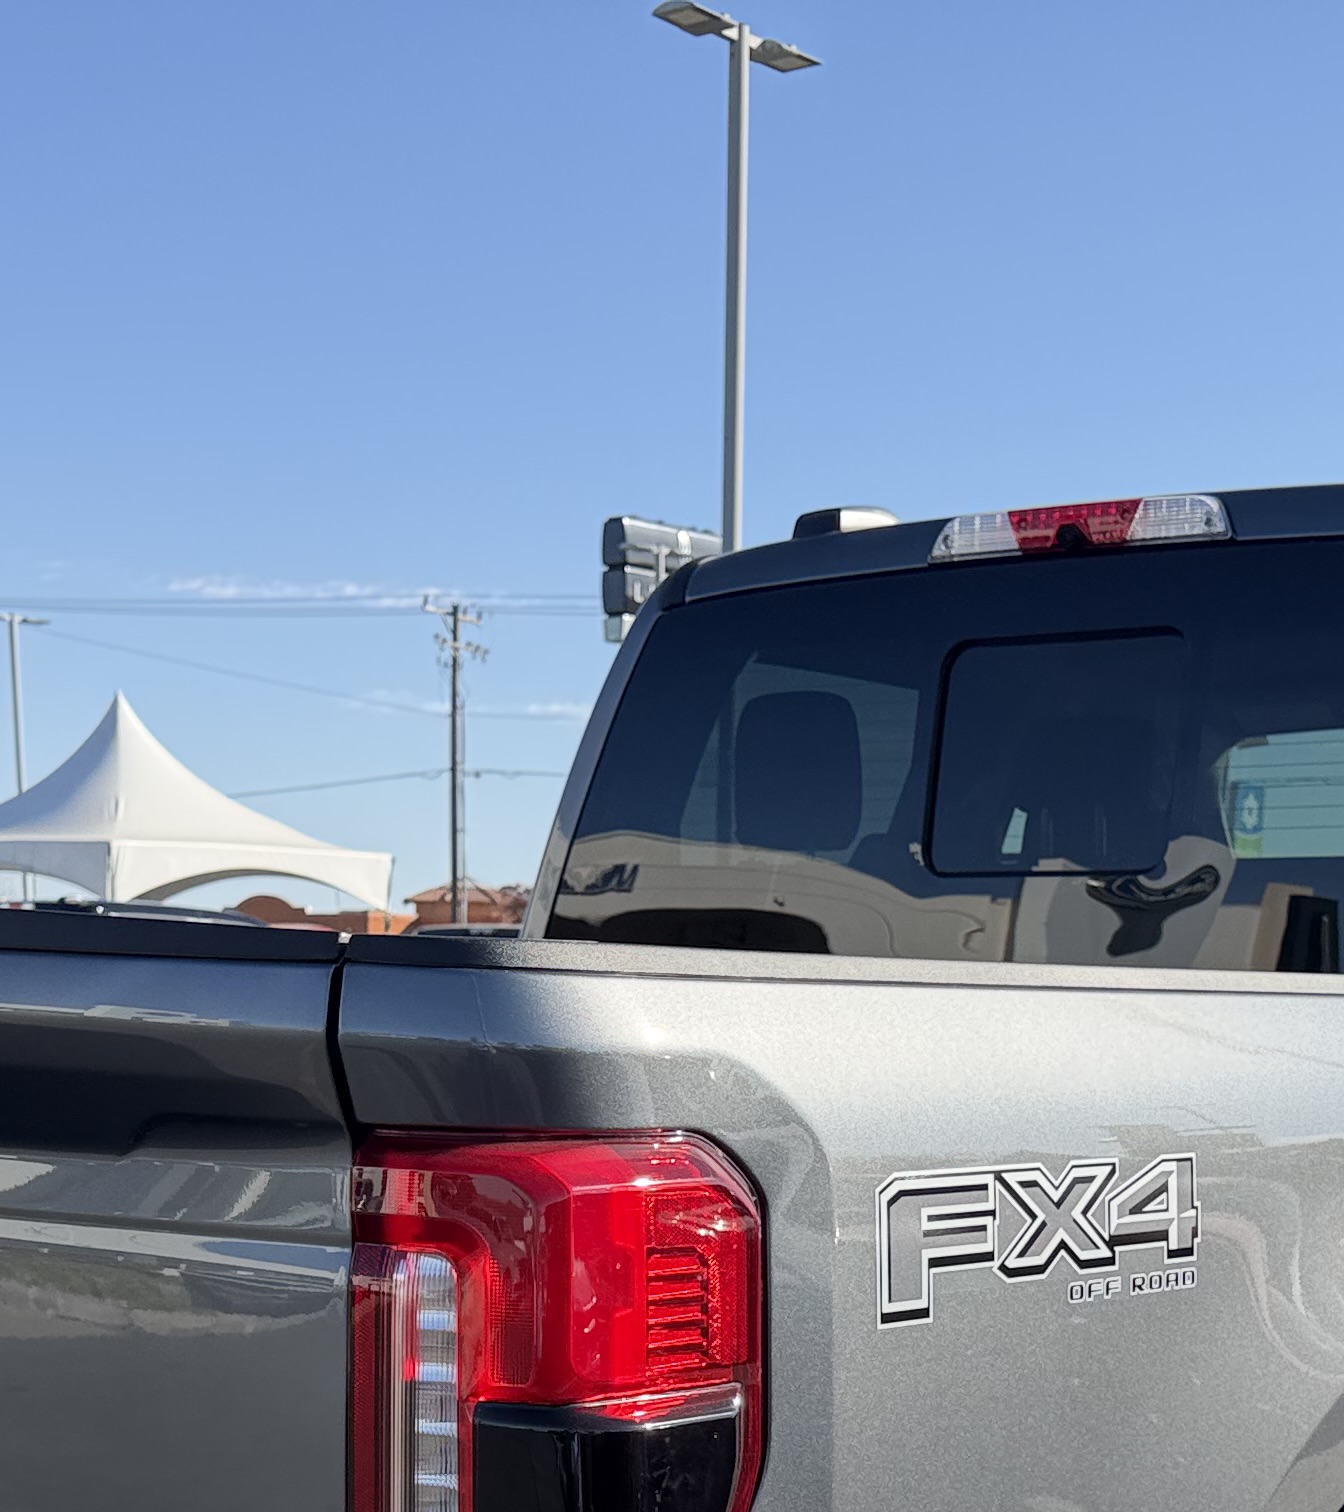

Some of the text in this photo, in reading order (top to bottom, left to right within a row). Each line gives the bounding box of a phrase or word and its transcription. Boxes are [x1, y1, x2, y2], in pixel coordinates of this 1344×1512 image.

[876, 1152, 1201, 1330] FX4
[1068, 1267, 1198, 1304] OFF ROAD
